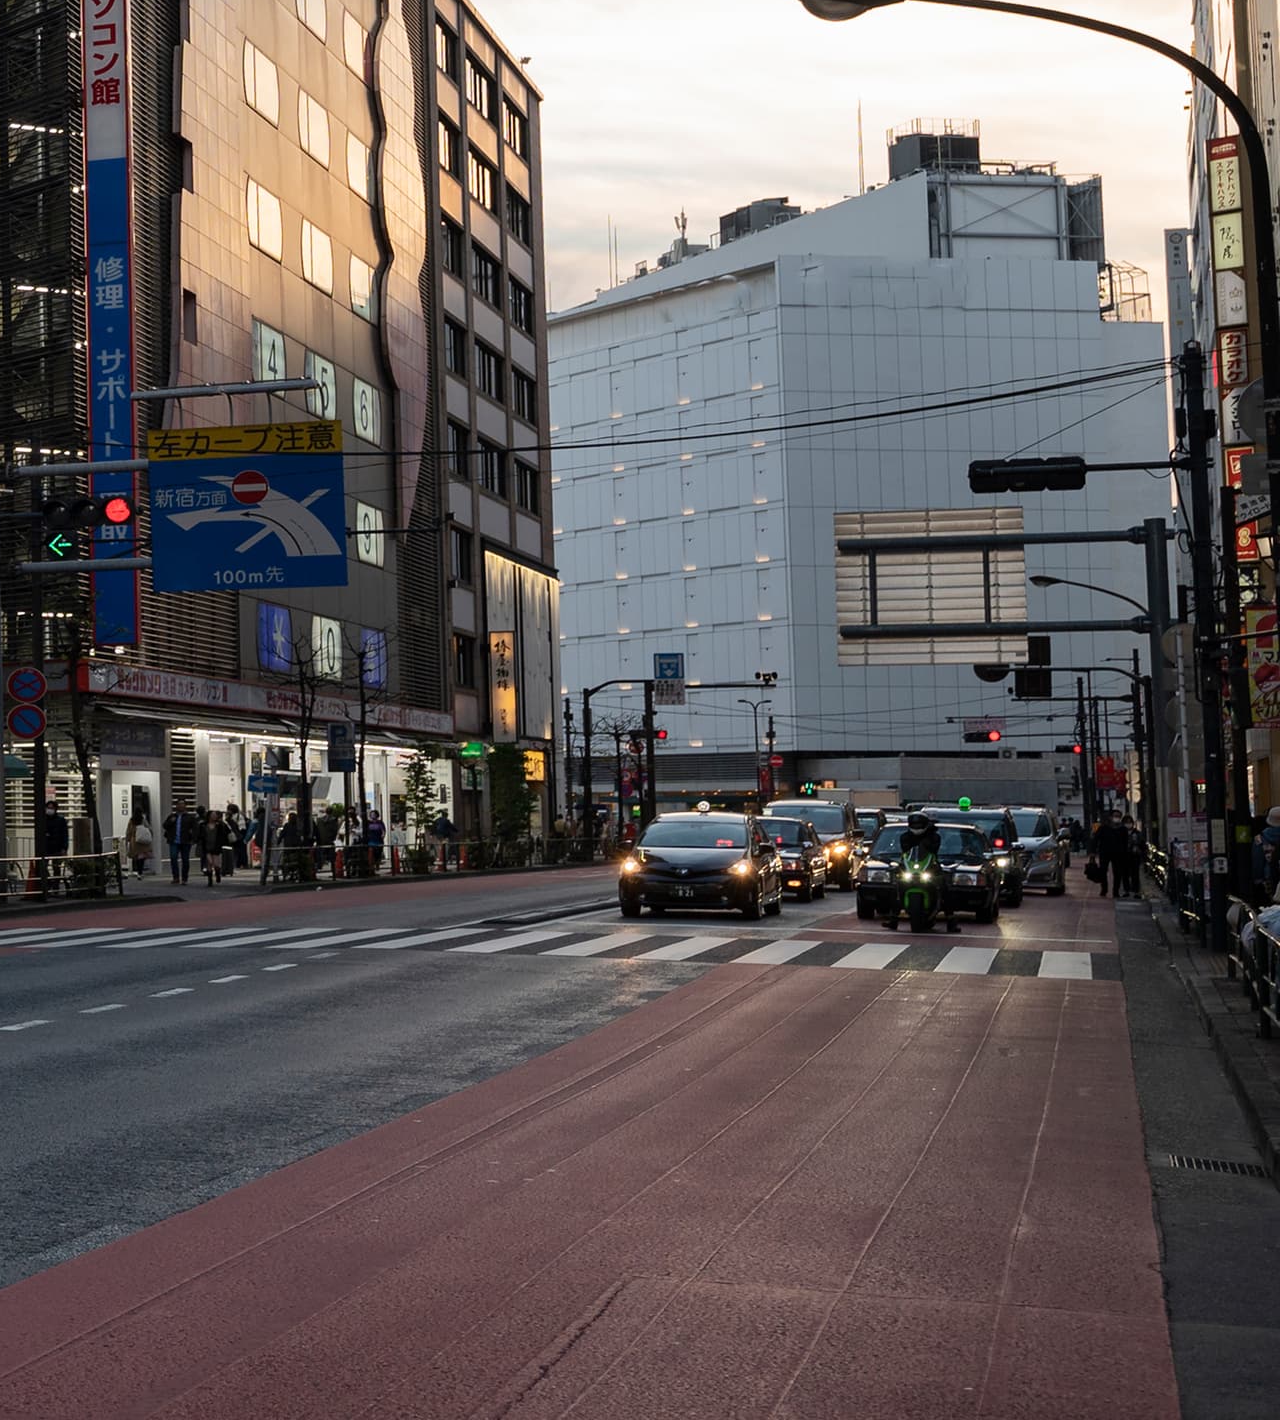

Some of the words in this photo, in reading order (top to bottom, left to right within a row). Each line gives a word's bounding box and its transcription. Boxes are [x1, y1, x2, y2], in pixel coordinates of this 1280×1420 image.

[1226, 333, 1243, 383] カラオケ
[154, 422, 336, 460] 左カーブ注意
[154, 487, 228, 509] 新宿方面
[213, 566, 285, 586] 100m先
